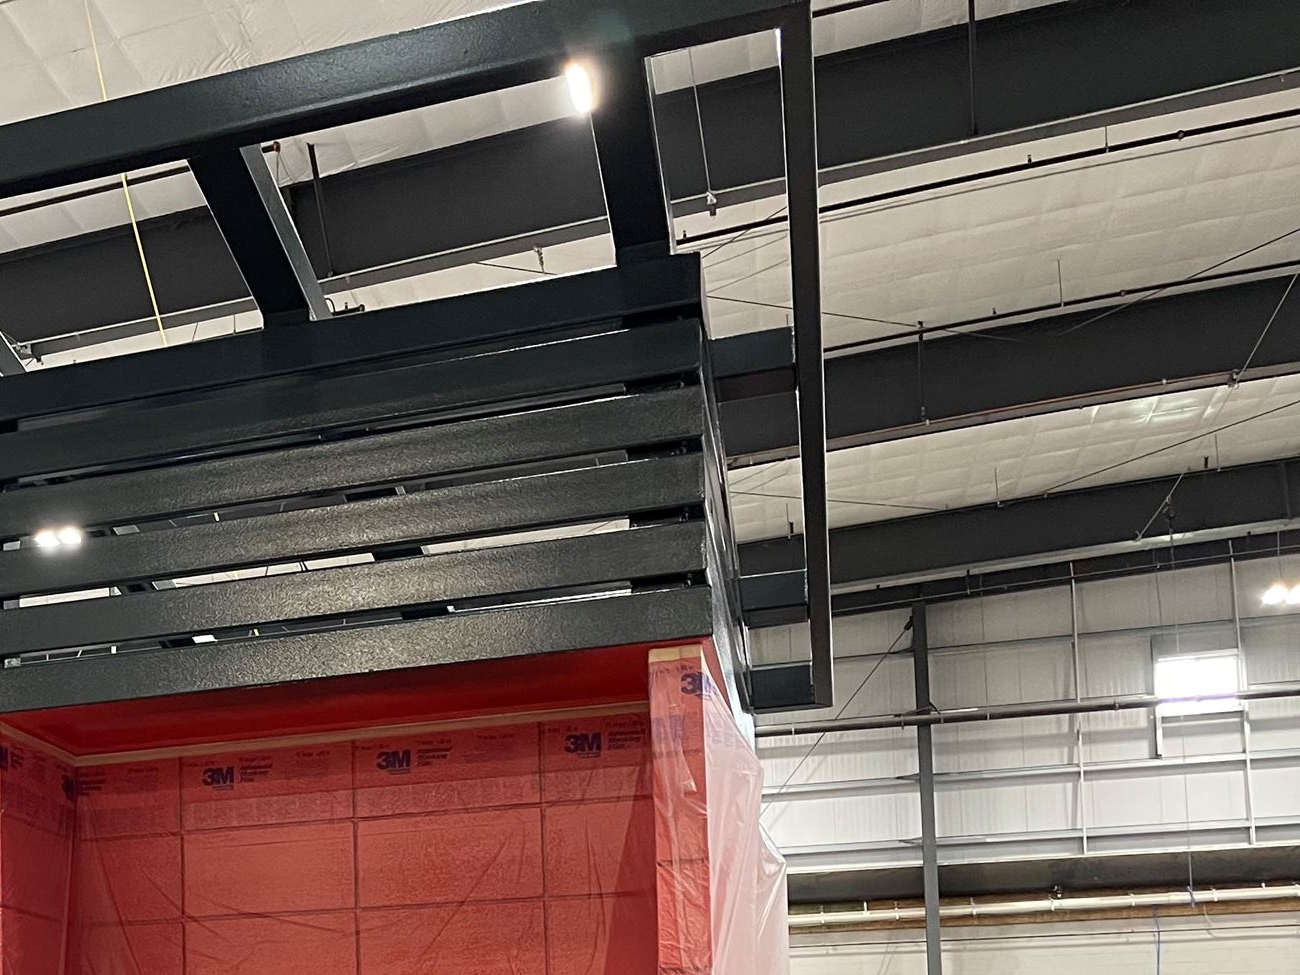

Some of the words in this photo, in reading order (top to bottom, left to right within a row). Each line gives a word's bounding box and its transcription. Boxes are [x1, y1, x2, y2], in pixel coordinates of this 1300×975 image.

[565, 732, 602, 754] 3M
[376, 749, 411, 770] 3M
[202, 766, 235, 786] 3M
